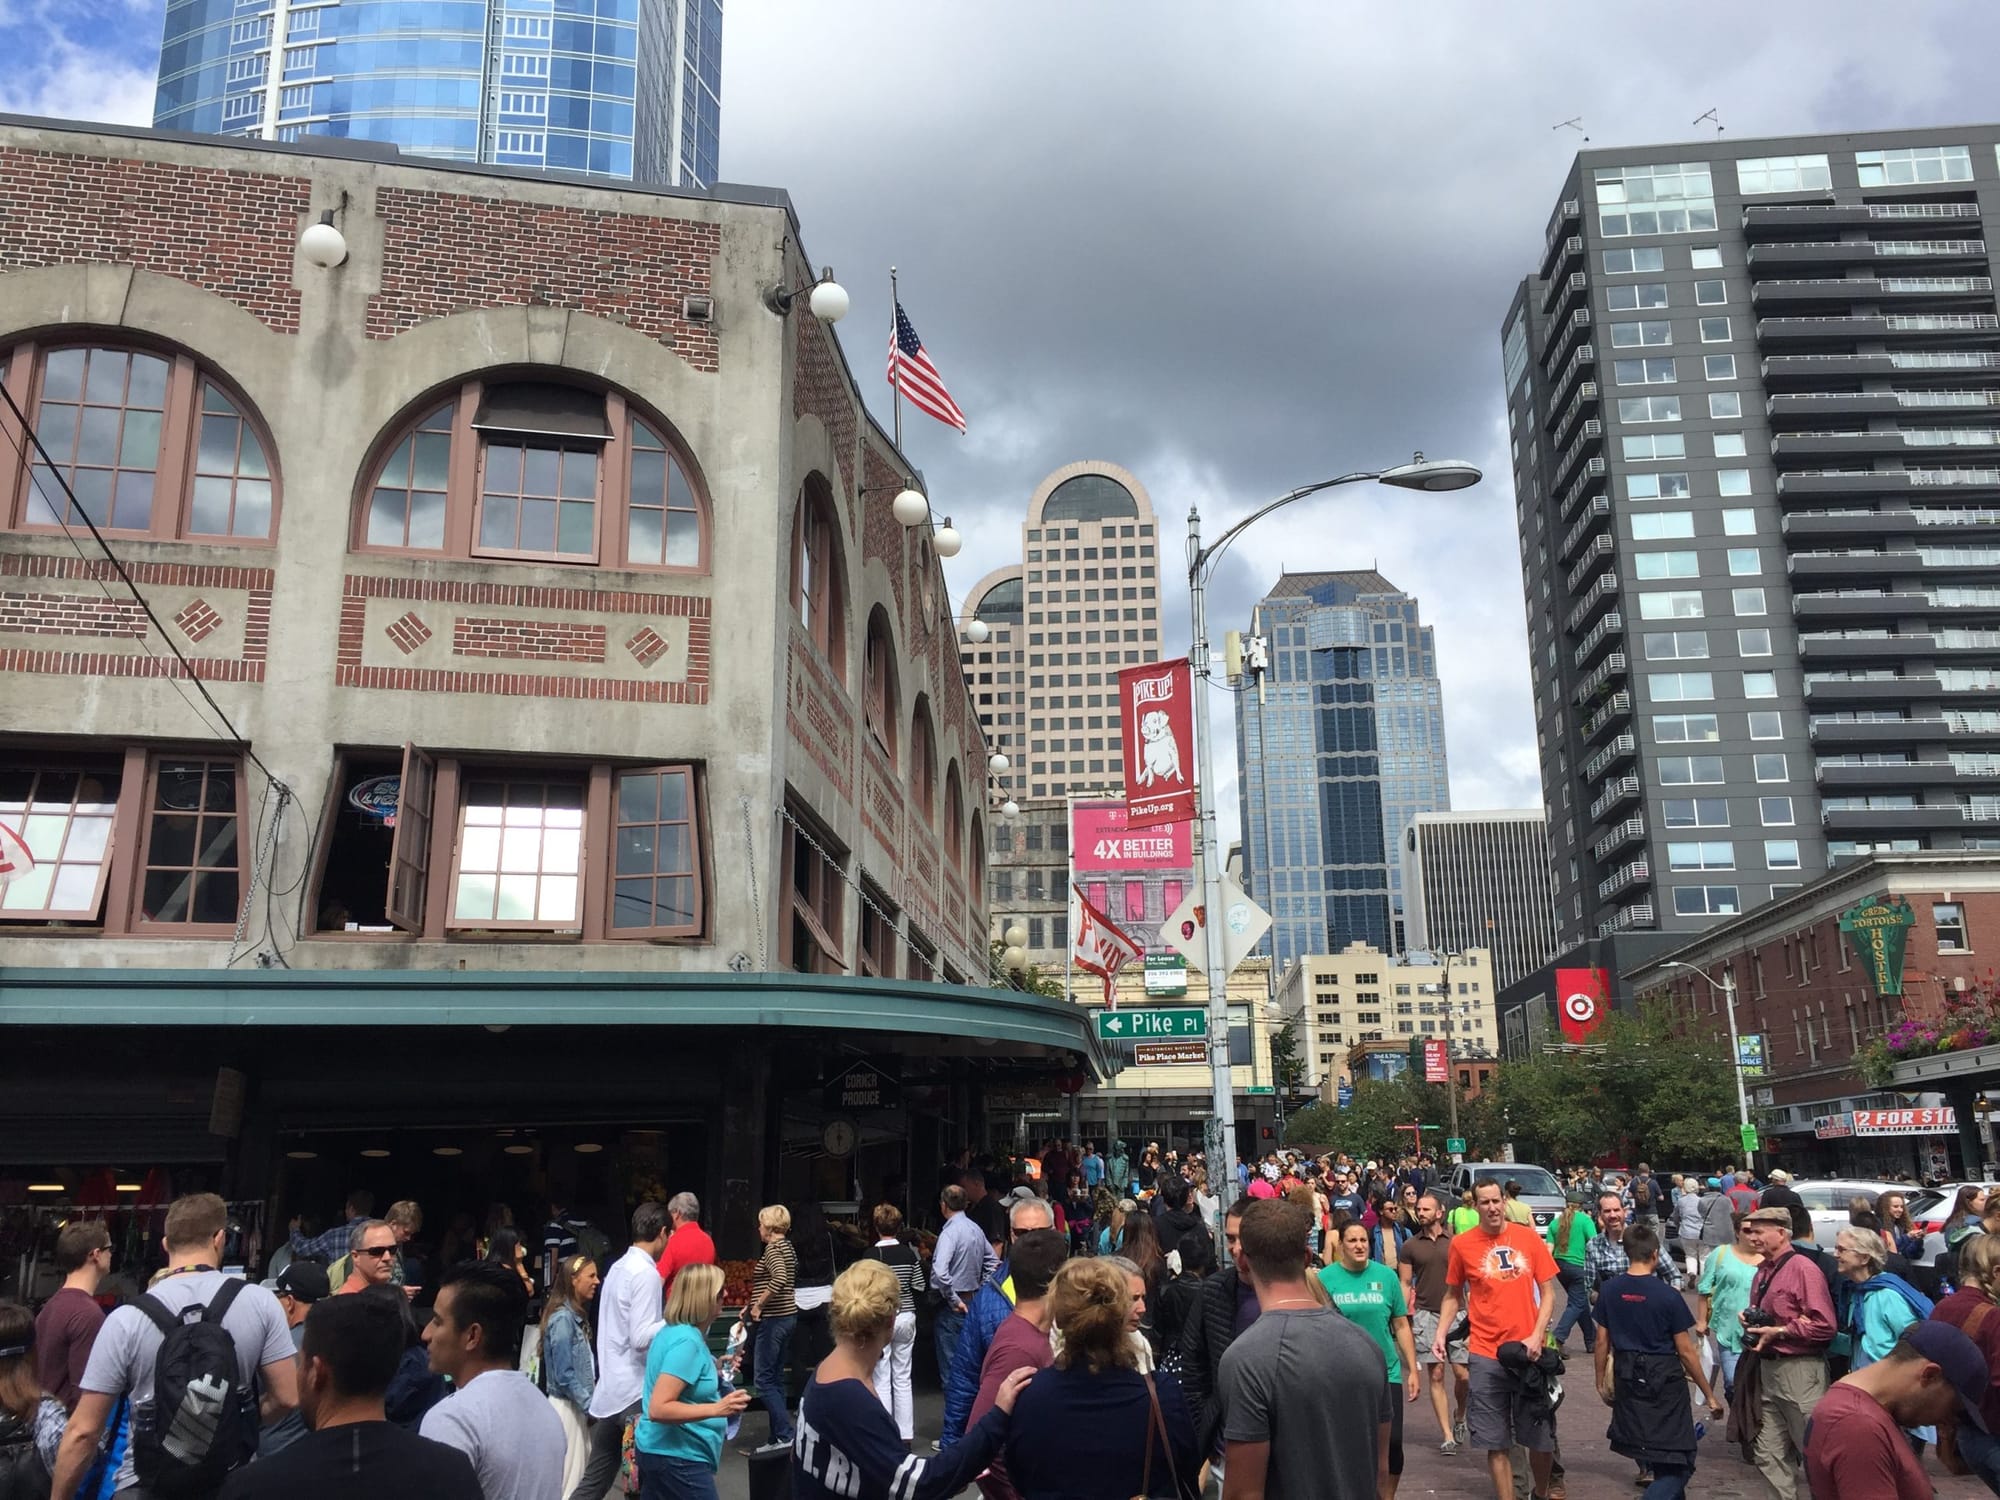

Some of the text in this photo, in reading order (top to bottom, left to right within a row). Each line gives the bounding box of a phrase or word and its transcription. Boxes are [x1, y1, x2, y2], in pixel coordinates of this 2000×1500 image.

[1136, 675, 1173, 700] PIKE UP!
[1130, 803, 1174, 817] PikeUp.org
[1093, 838, 1173, 859] 4X BETTER
[1133, 850, 1174, 858] BUILDINGS
[1861, 906, 1890, 917] GREEN
[1852, 914, 1903, 928] TORTOISE
[1870, 927, 1888, 994] HOSTEL
[1132, 1014, 1197, 1033] Pike Pl
[1177, 1051, 1205, 1060] Market
[1741, 1057, 1762, 1065] PIKE
[1743, 1066, 1763, 1075] PINE
[845, 1072, 878, 1088] CORNER
[841, 1090, 880, 1107] PRODUCE
[1858, 1112, 1870, 1126] 2
[1876, 1111, 1914, 1125] FOR
[1921, 1108, 1956, 1124] $10
[1333, 1292, 1384, 1304] IRELAND
